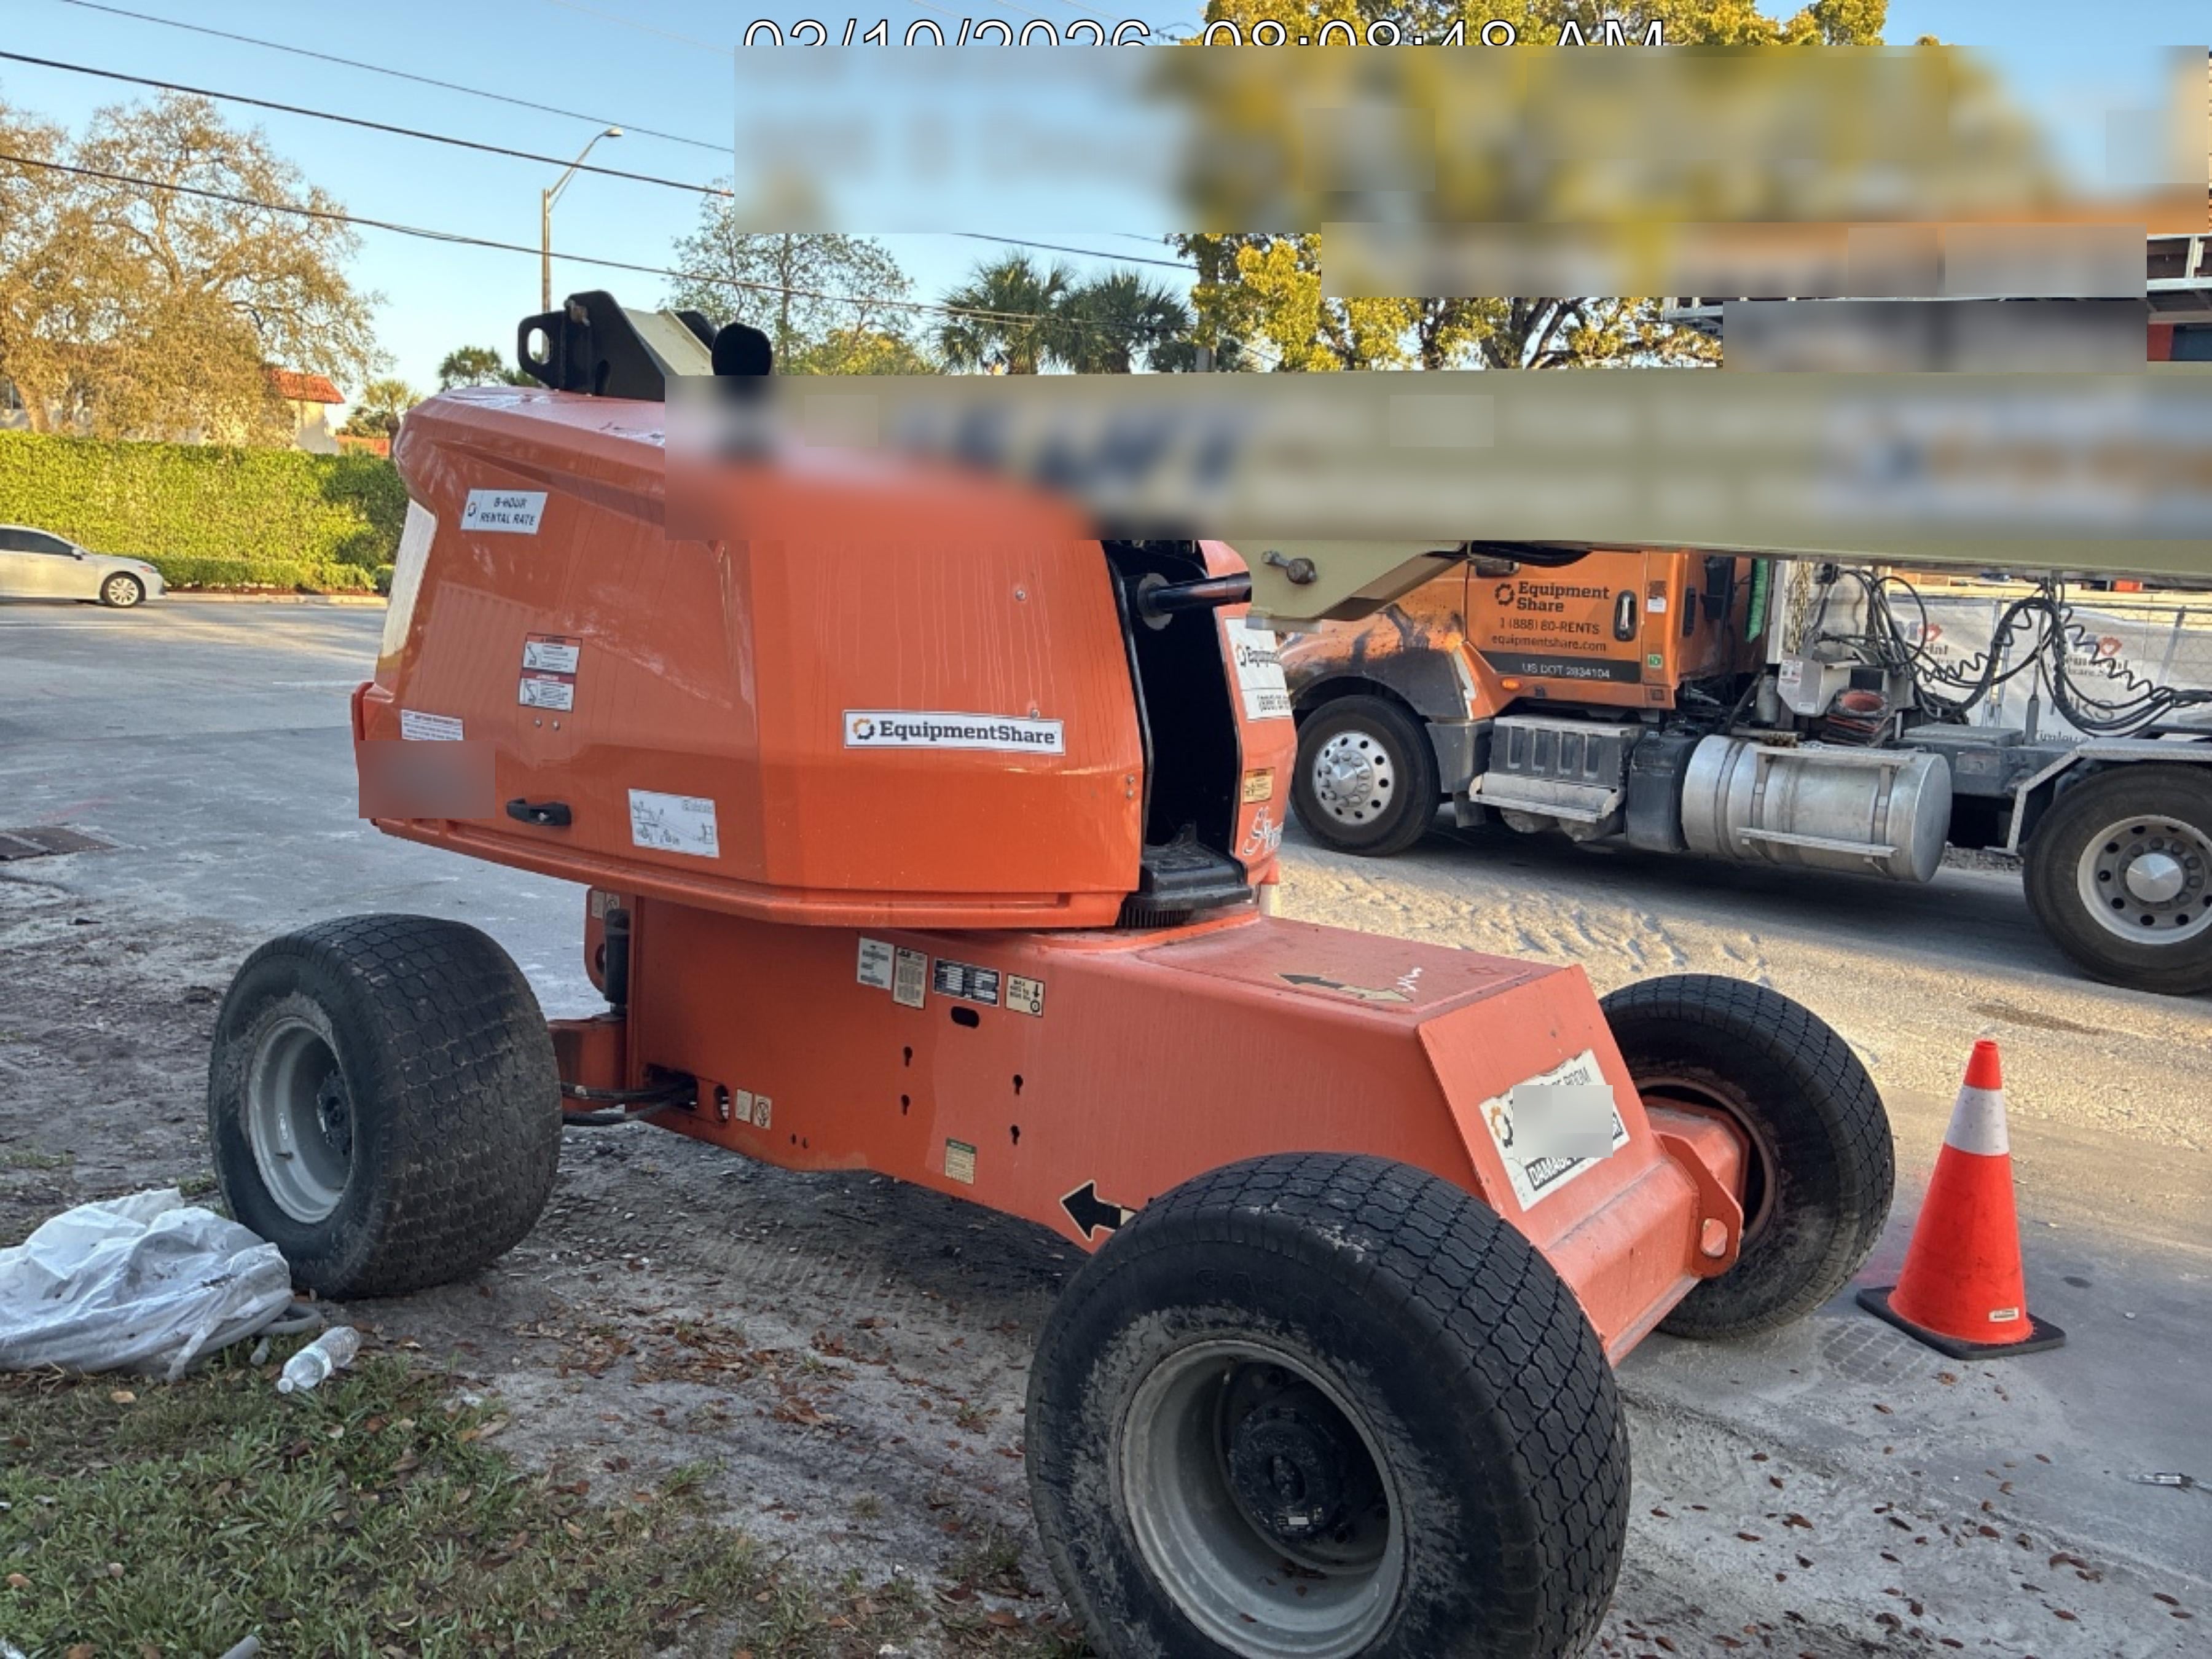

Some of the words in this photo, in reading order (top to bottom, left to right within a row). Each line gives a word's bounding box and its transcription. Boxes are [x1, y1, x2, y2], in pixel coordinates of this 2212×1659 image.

[480, 512, 510, 524] RENTAL
[512, 514, 536, 526] RATE
[1518, 581, 1609, 600] Equipment
[1516, 597, 1564, 613] Share
[1492, 634, 1606, 651] equipmentshare.com
[1522, 662, 1537, 674] US
[1540, 664, 1564, 676] DOT
[879, 720, 1056, 744] EquipmentShare
